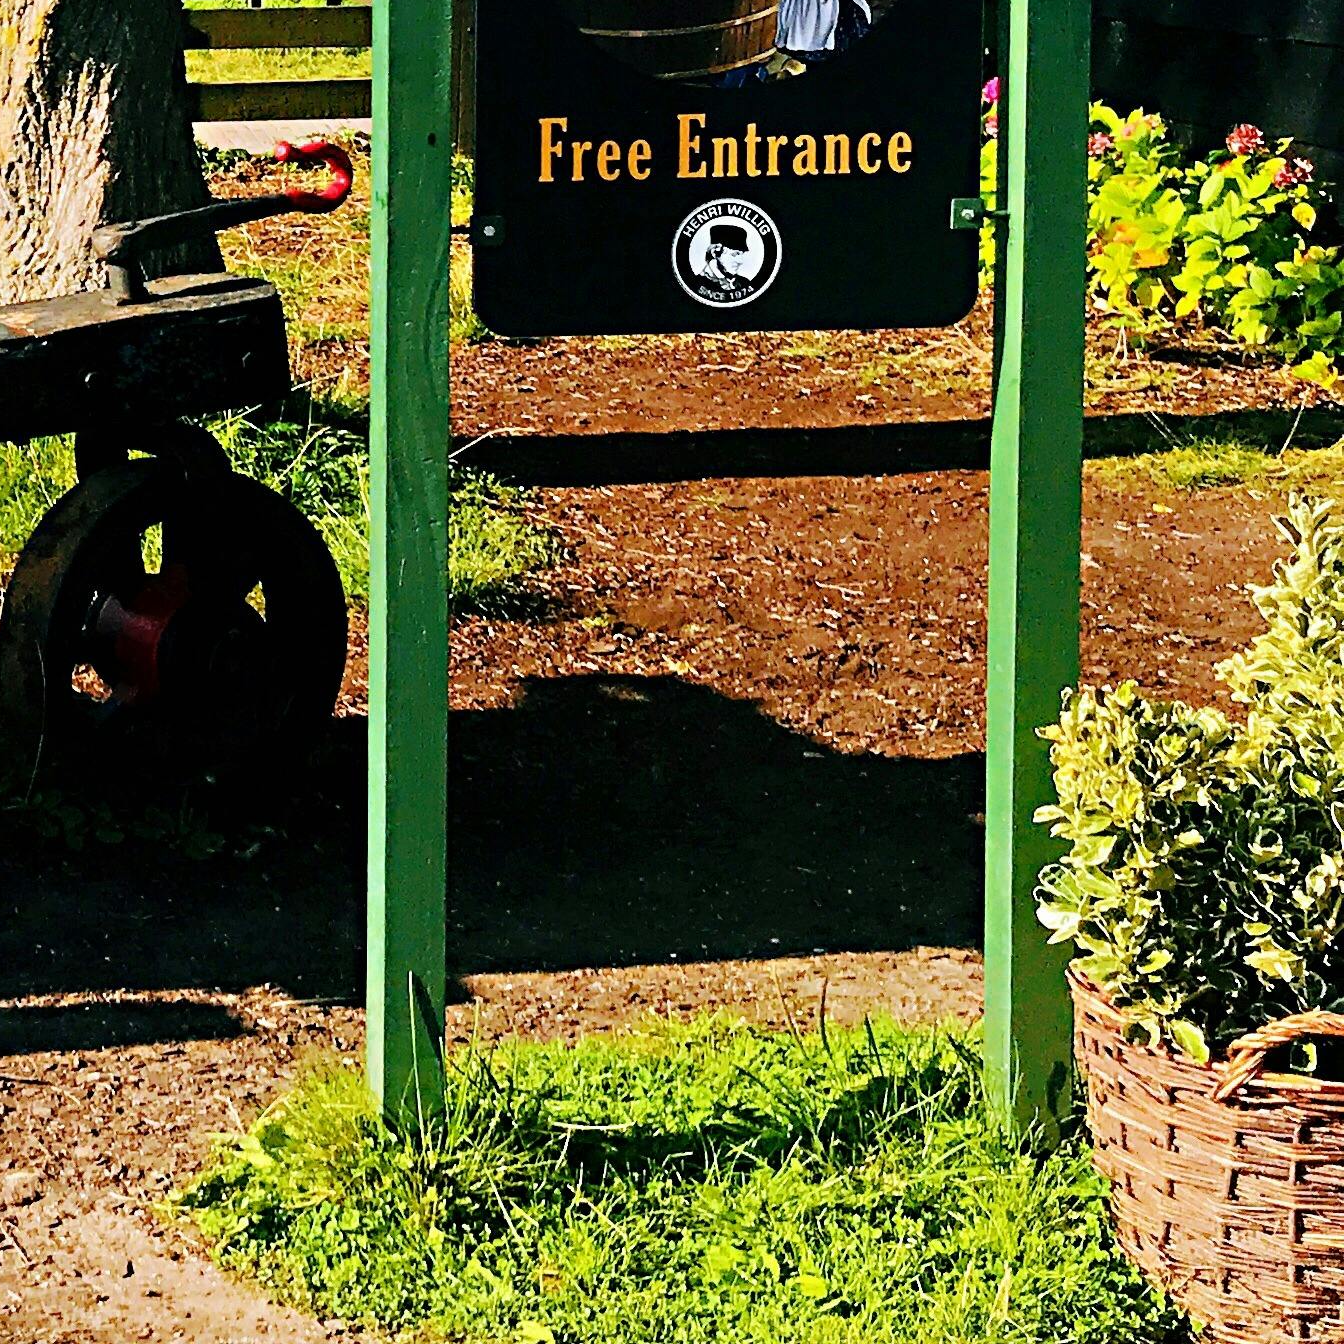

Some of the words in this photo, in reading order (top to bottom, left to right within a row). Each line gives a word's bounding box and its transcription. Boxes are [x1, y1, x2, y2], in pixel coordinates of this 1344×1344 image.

[538, 117, 652, 183] Free
[676, 113, 913, 179] Entrance
[682, 205, 722, 238] HENRI
[727, 204, 771, 236] WILLIG
[698, 285, 725, 301] SINCE
